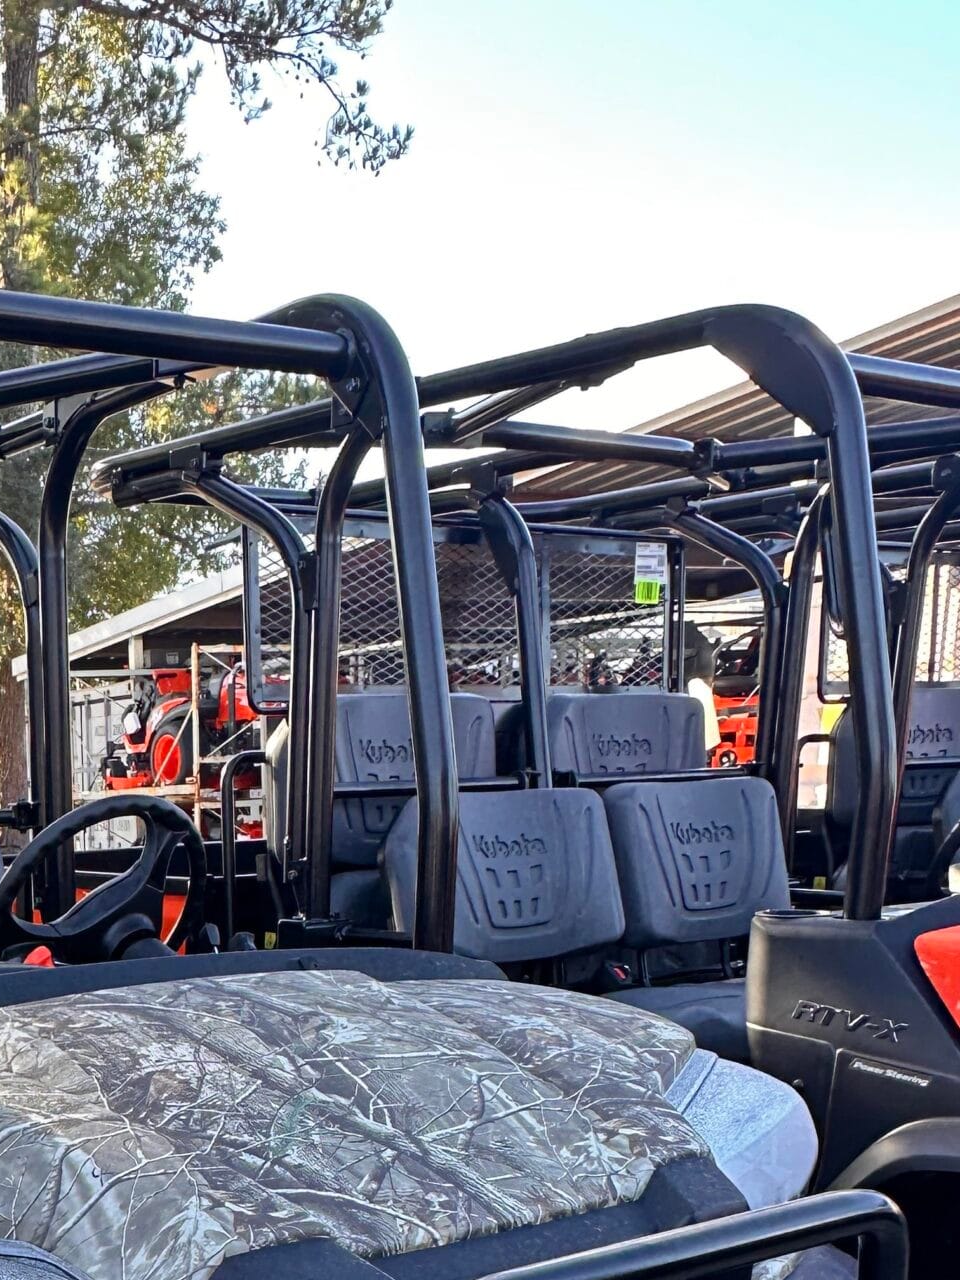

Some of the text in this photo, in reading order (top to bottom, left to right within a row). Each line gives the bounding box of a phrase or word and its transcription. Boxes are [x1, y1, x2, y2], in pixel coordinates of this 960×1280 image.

[359, 738, 412, 764] Kubo
[472, 832, 548, 859] Kubota
[671, 820, 735, 845] Kubota
[791, 999, 910, 1043] RTV-X
[853, 1061, 929, 1087] Power Steering
